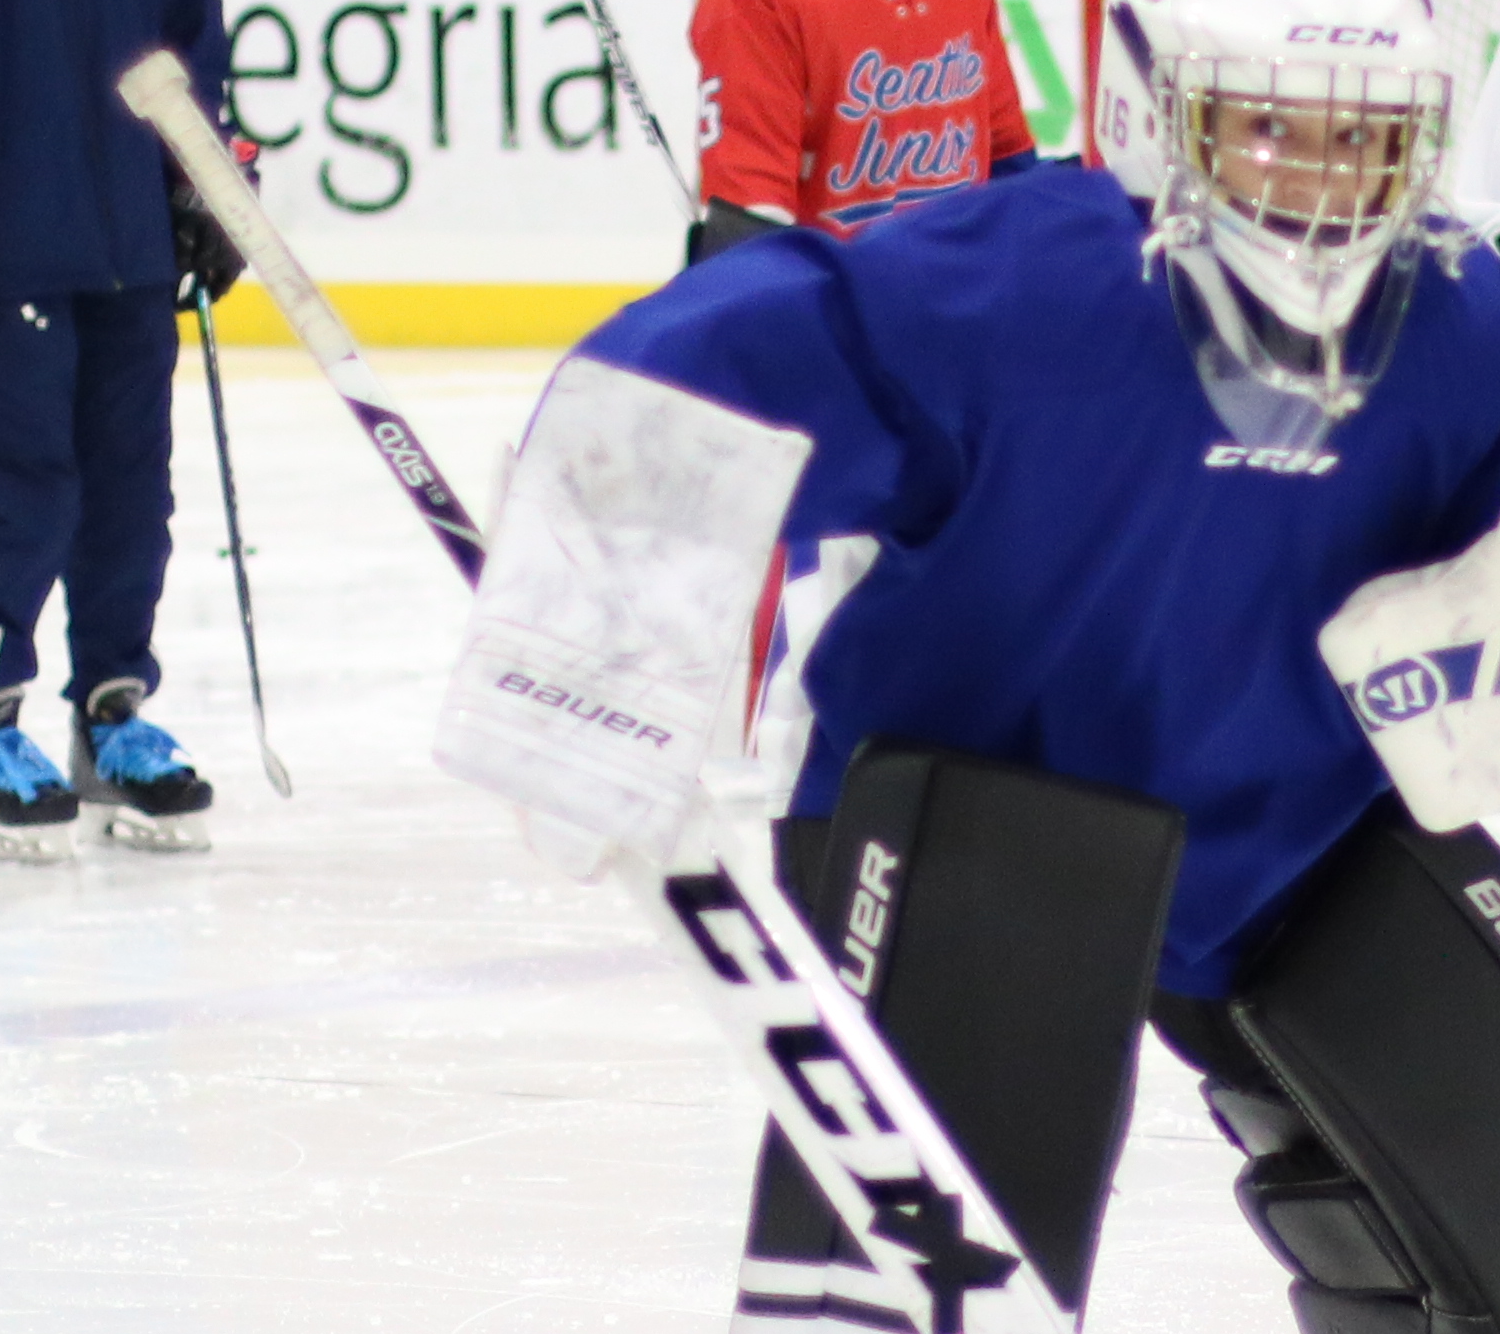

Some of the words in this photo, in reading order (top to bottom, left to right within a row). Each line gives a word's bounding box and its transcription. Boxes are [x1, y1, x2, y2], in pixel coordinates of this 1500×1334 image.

[1287, 24, 1398, 49] CCM
[1204, 445, 1339, 475] CCM
[495, 672, 673, 749] BAUER
[838, 840, 899, 997] UER
